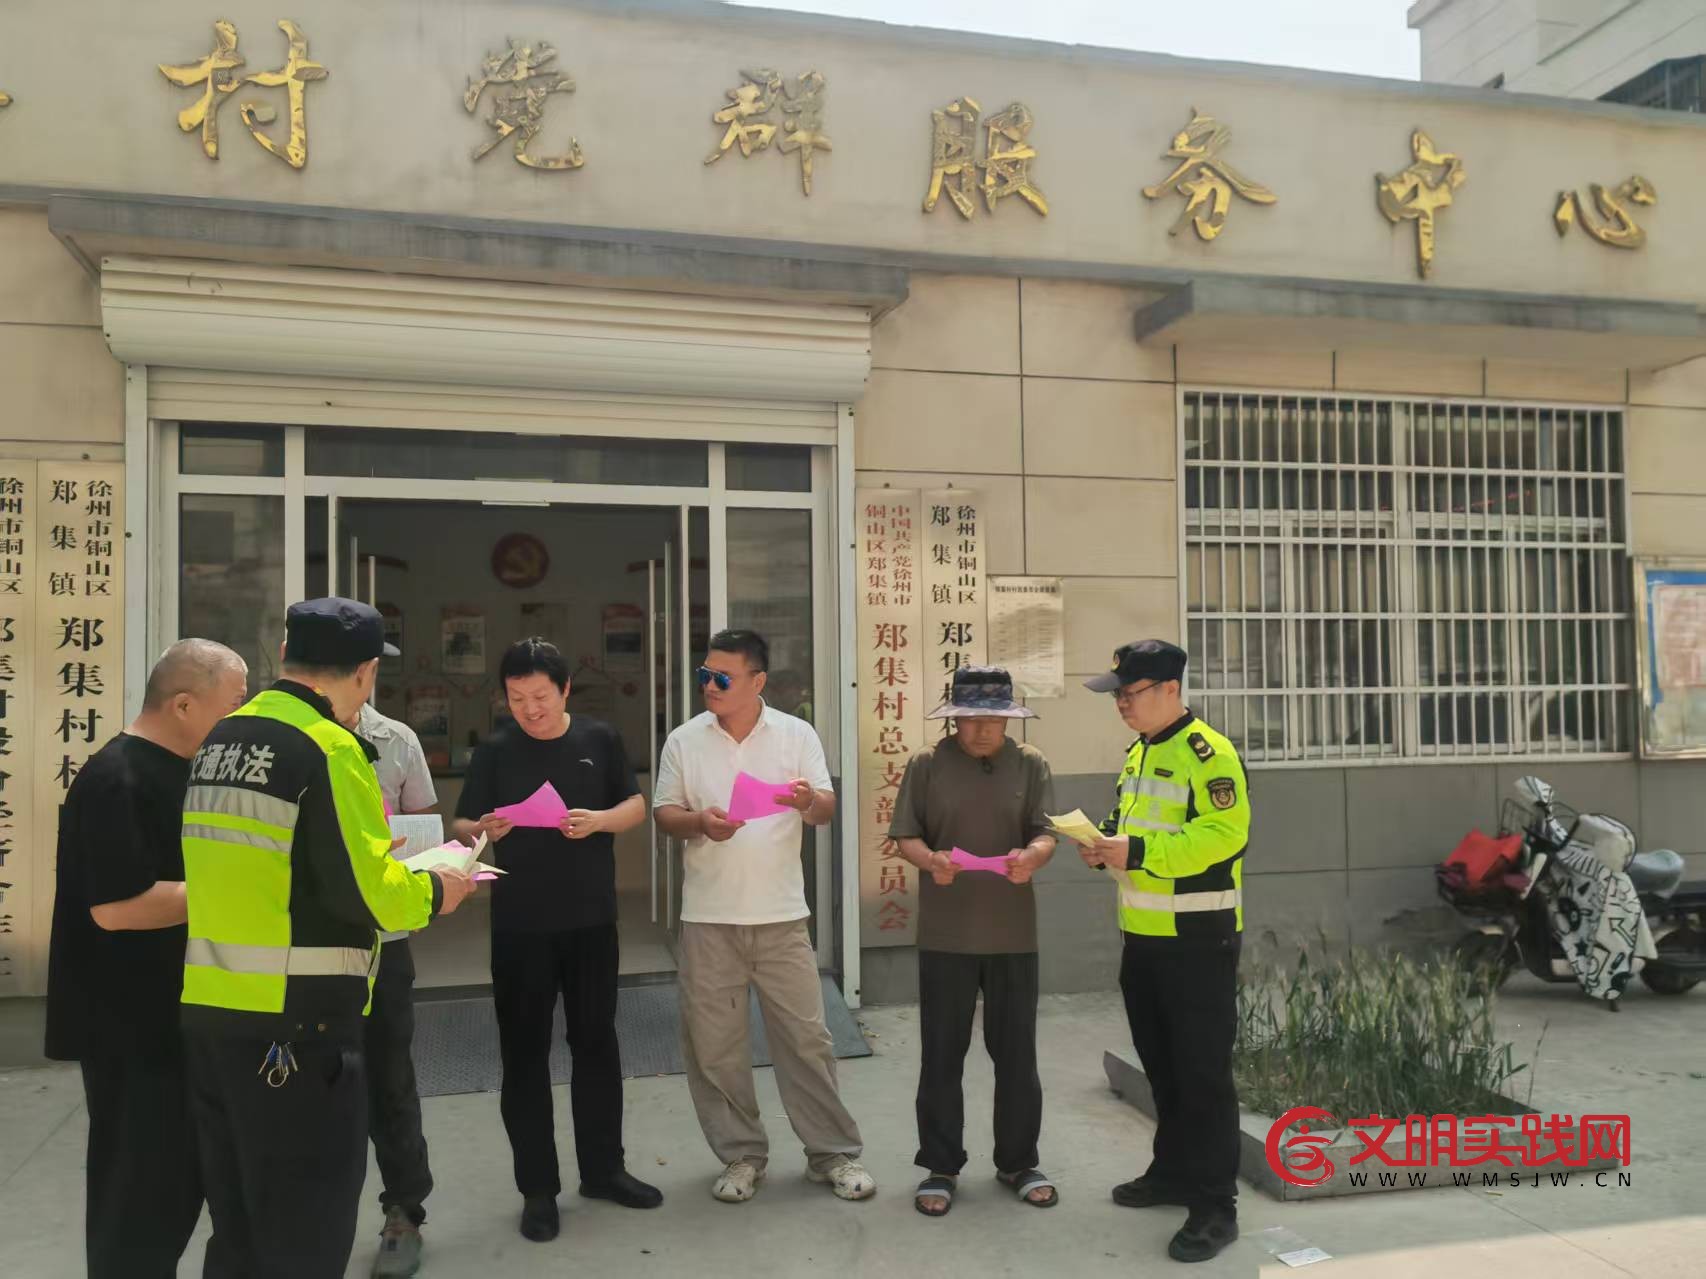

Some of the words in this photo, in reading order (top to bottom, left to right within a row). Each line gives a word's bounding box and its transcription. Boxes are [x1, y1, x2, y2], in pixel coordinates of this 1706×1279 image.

[0, 18, 1656, 278] 村党群服务中心
[0, 477, 24, 595] 徐州市铜山区
[49, 479, 77, 596] 郑集镇
[85, 480, 112, 596] 徐州市铜山区
[865, 504, 888, 606] 铜山区郑集镇
[891, 504, 912, 606] 中国共产党徐州市
[931, 505, 952, 605] 郑集镇
[956, 505, 976, 605] 徐州市铜山区
[54, 617, 104, 838] 郑集村村
